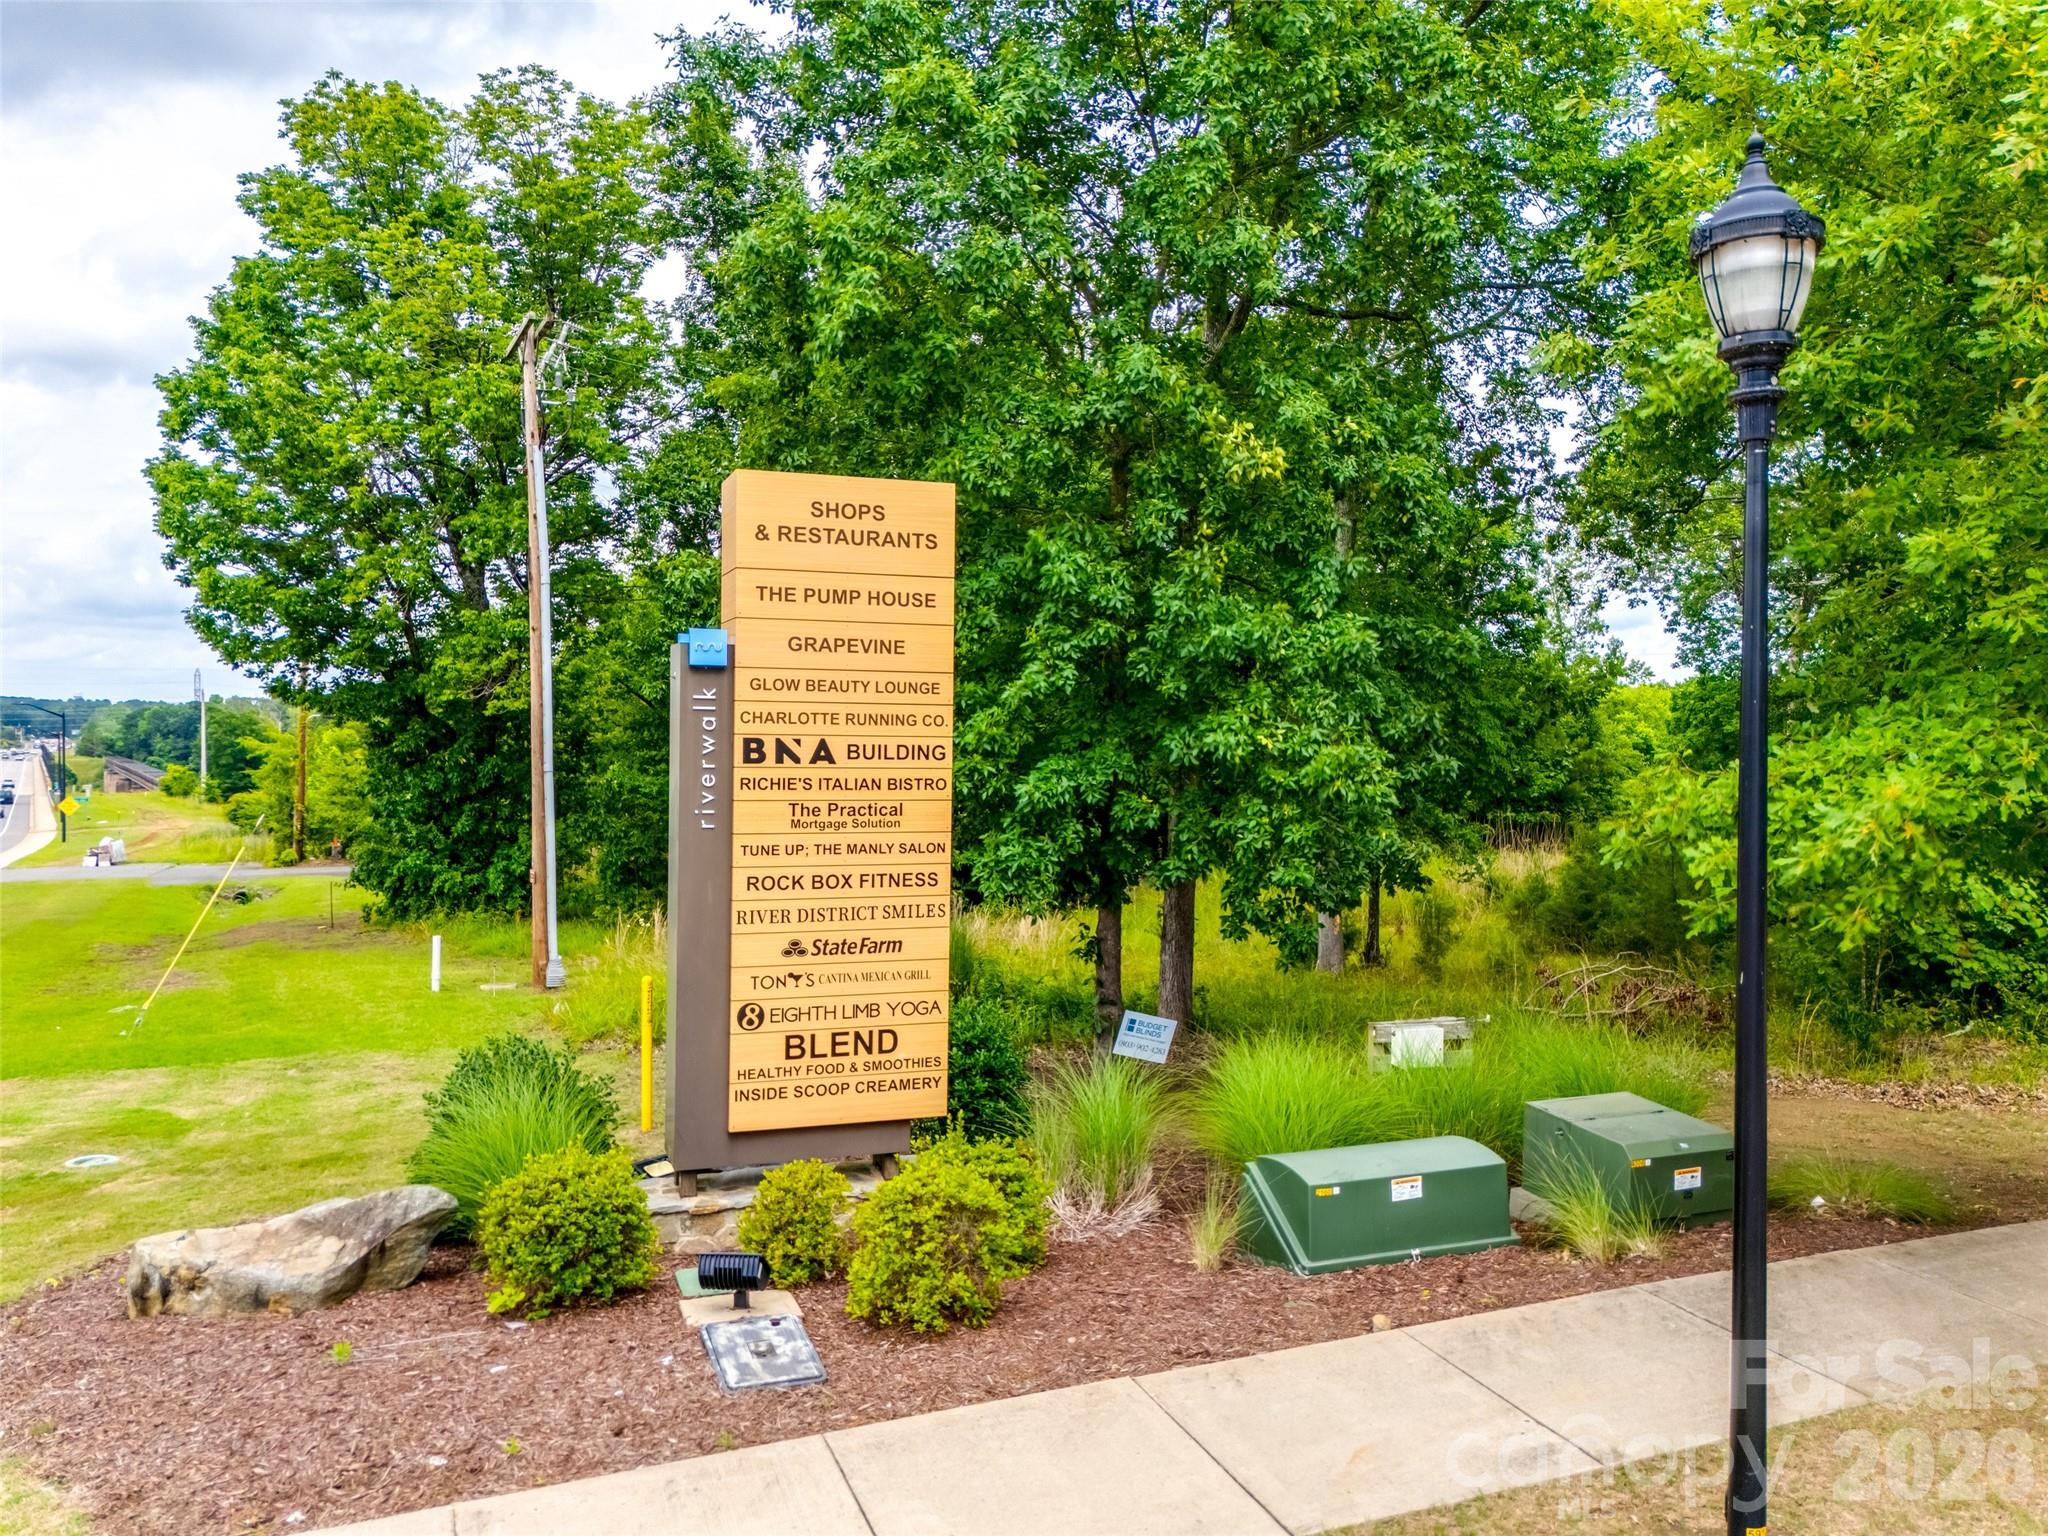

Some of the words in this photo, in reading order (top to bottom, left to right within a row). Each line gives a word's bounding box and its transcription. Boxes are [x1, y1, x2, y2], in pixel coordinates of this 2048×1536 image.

[810, 501, 885, 521] SHOPS
[755, 524, 769, 541] &
[778, 526, 938, 549] RESTAURANTS
[756, 586, 796, 602] THE
[804, 588, 861, 605] PUMP
[868, 591, 936, 608] HOUSE
[788, 637, 905, 654] GRAPEVINE
[750, 678, 800, 691] GLOW
[806, 680, 870, 693] BEAUTY
[876, 681, 940, 694] LOUNGE
[740, 711, 840, 725] CHARLOTTE
[846, 713, 917, 726] RUNNING
[922, 714, 948, 727] CO.
[692, 688, 717, 829] riverwalk
[742, 737, 836, 764] BNA
[847, 744, 946, 761] BUILDING
[740, 777, 812, 791] RICHIE'S
[819, 778, 881, 791] ITALIAN
[888, 778, 947, 790] BISTRO
[789, 803, 821, 817] The
[828, 802, 903, 817] Practical
[791, 819, 847, 831] Mortgage
[852, 819, 900, 829] Solution
[741, 845, 779, 856] TUNE
[785, 844, 809, 856] UP;
[814, 844, 841, 855] THE
[847, 843, 894, 854] MANLY
[899, 843, 945, 854] SALON
[747, 875, 804, 891] ROCK
[812, 874, 852, 890] BOX
[860, 872, 938, 888] FITNESS
[736, 909, 791, 925] RIVER
[797, 906, 878, 923] DISTRICT
[883, 904, 946, 919] SMILES
[819, 972, 858, 984] CANTINA
[861, 971, 901, 982] MEXICAN
[904, 970, 931, 980] GRILL
[770, 1006, 836, 1023] EIGHTH
[843, 1004, 880, 1019] LIMB
[887, 1001, 942, 1017] YOGA
[1135, 1027, 1162, 1038] BLINDS
[1137, 1020, 1168, 1032] BUDGET
[785, 1029, 898, 1061] BLEND
[737, 1066, 802, 1080] HEALTHY
[807, 1064, 844, 1075] FOOD
[850, 1062, 858, 1073] &
[863, 1057, 942, 1072] SMOOTHIES
[735, 1087, 787, 1102] INSIDE
[794, 1083, 849, 1098] SCOOP
[856, 1077, 942, 1094] CREAMERY
